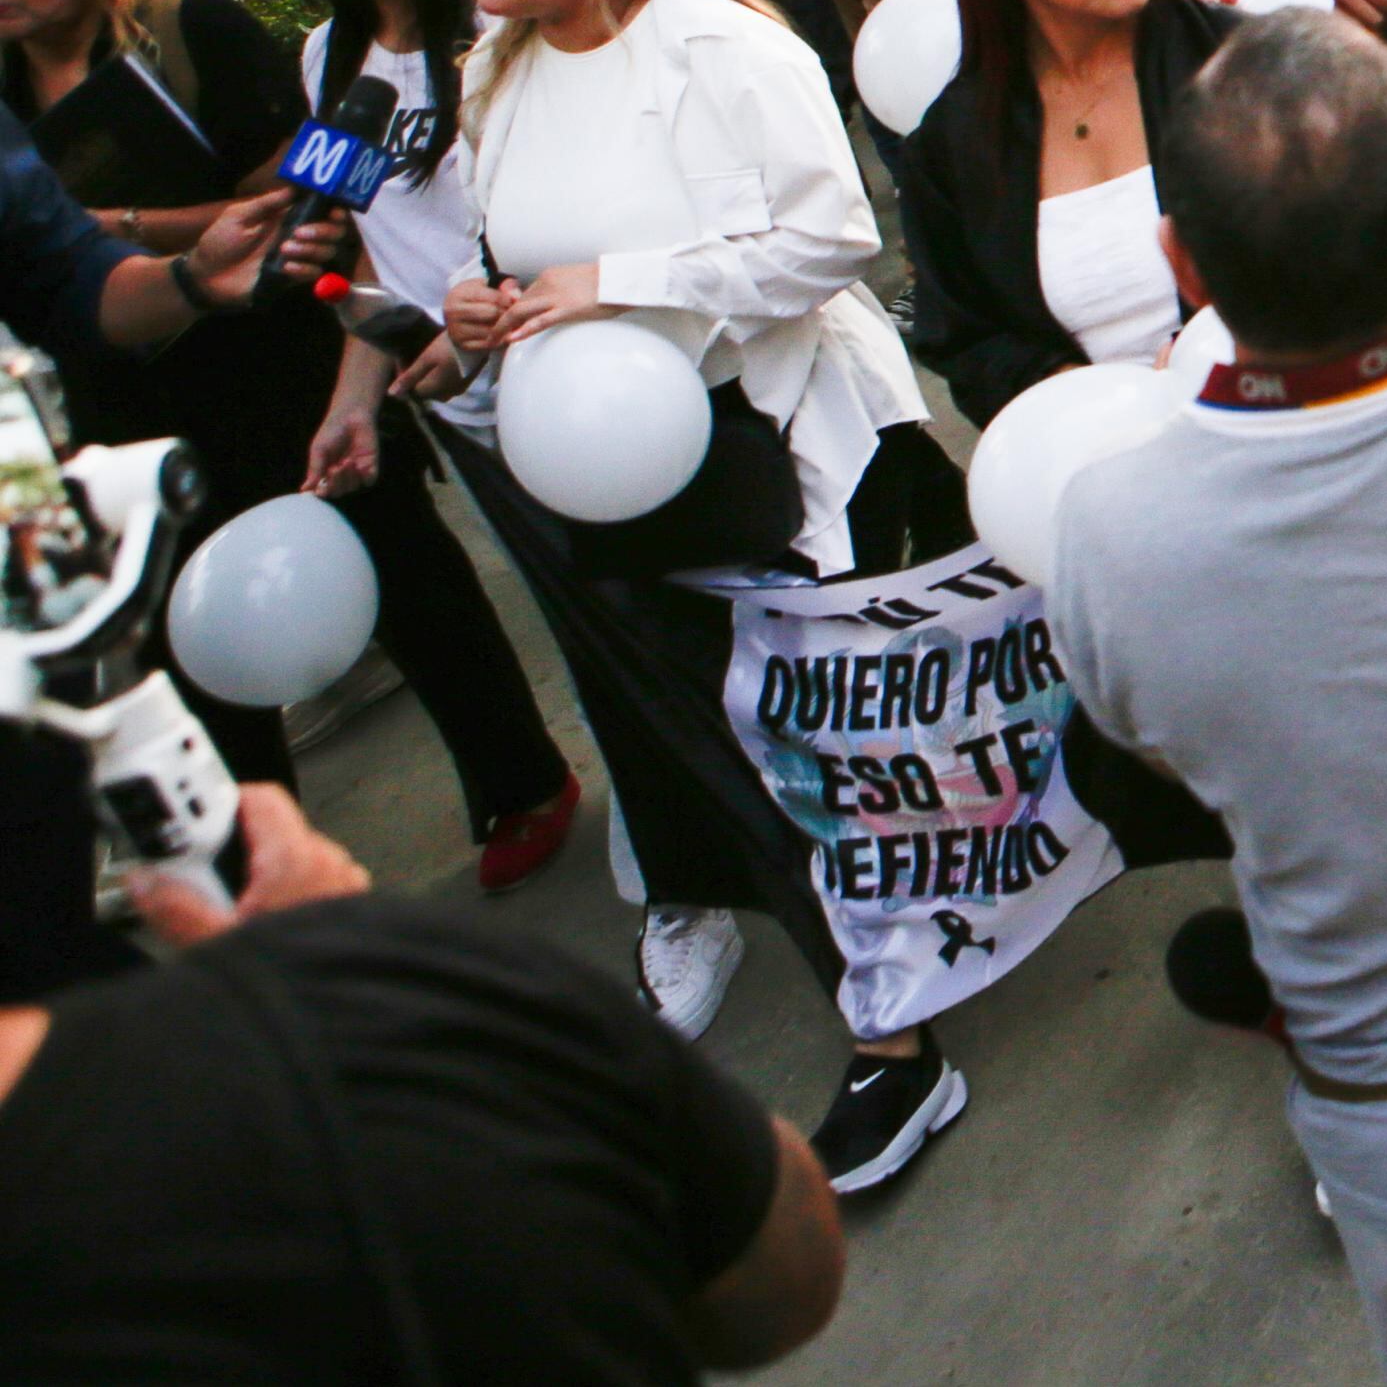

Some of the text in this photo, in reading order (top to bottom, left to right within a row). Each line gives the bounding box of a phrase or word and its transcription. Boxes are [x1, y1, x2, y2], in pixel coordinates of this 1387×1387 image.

[757, 619, 1067, 741] QUIERO POR
[815, 718, 1043, 816] ESO TE
